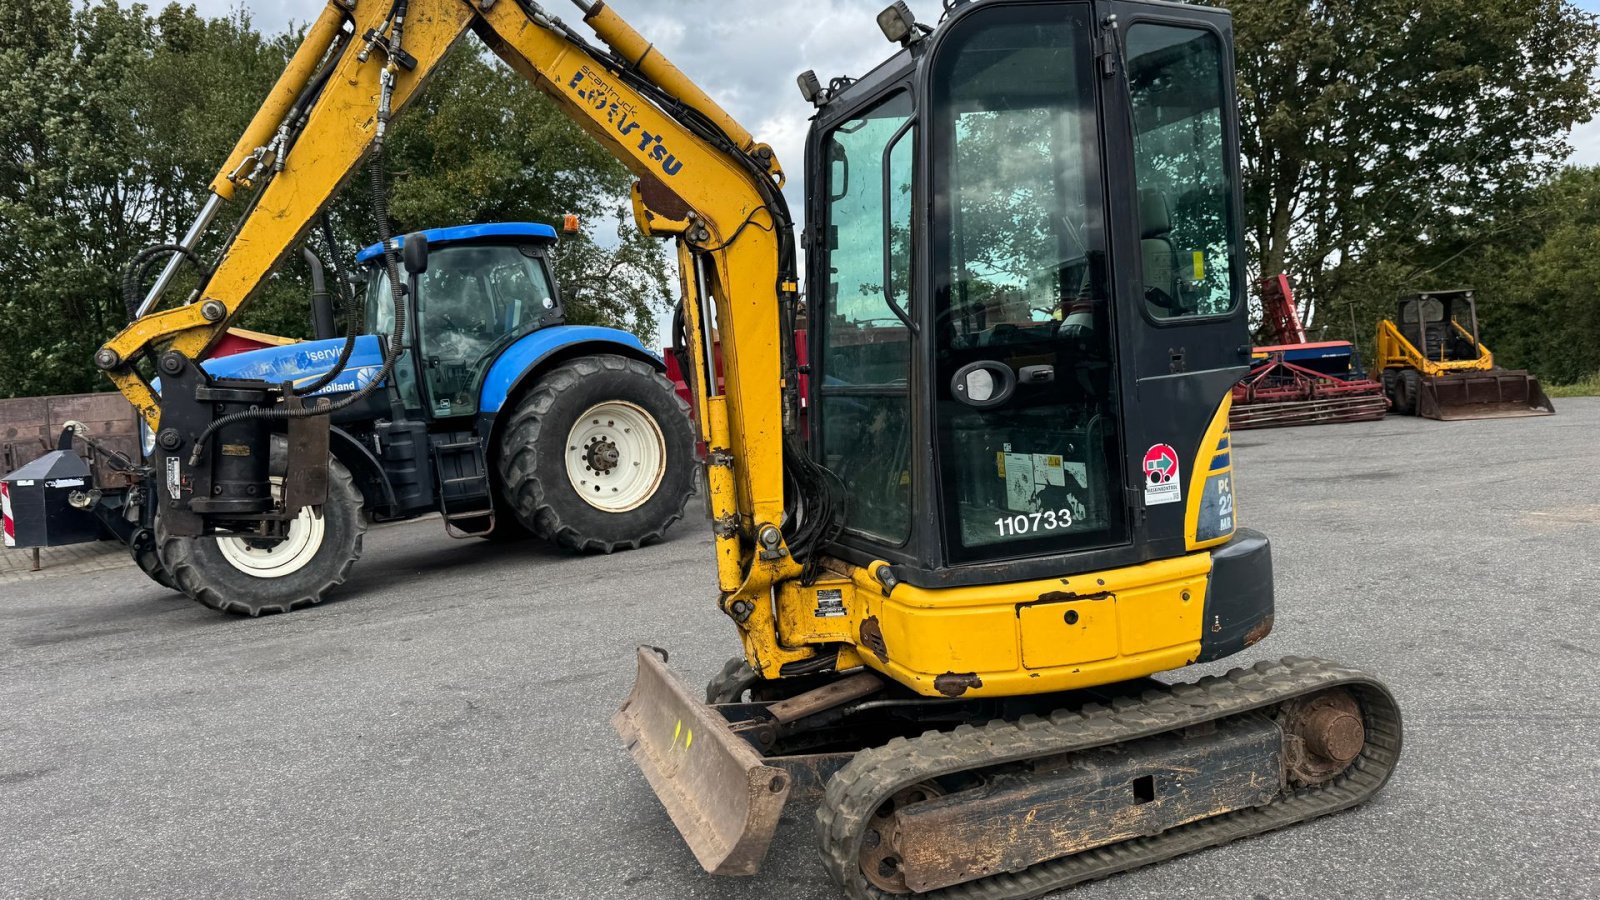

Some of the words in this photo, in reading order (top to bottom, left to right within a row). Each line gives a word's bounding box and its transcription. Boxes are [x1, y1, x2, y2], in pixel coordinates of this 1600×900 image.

[580, 65, 638, 117] scantruck
[1217, 477, 1229, 494] PC
[1219, 493, 1232, 516] 22
[994, 508, 1072, 536] 110733
[1220, 516, 1232, 531] MR
